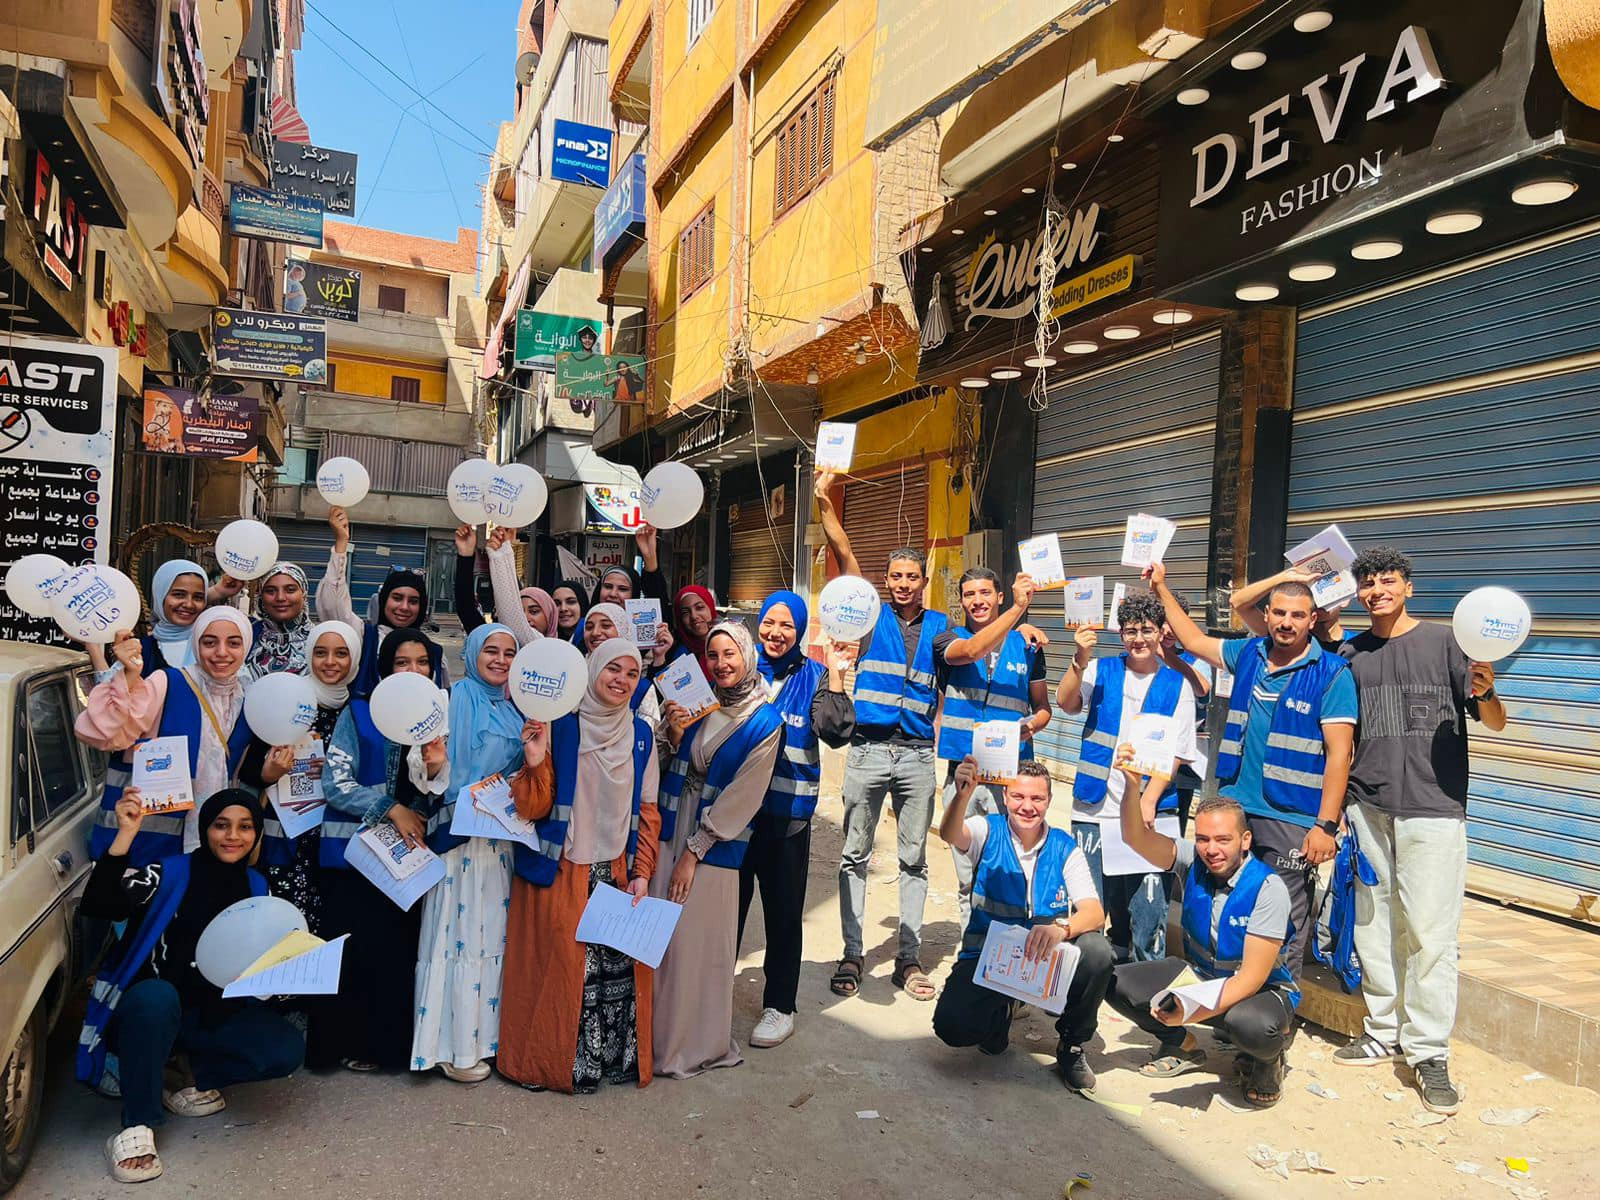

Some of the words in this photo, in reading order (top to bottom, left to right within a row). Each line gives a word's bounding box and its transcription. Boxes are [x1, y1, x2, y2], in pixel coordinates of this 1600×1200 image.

[1189, 25, 1447, 209] DEVA
[301, 145, 330, 162] مركز
[274, 159, 307, 177] سلامة
[1240, 150, 1384, 235] FASHION
[34, 149, 88, 276] FAST
[960, 202, 1100, 332] Queen
[1087, 264, 1130, 293] Dresses
[234, 315, 255, 327] لاب
[257, 319, 296, 331] ميكرو
[534, 329, 577, 350] البوابة
[0, 392, 20, 404] ER
[23, 394, 89, 411] SERVICES
[8, 486, 40, 501] بجميع
[45, 484, 81, 503] طباعة
[4, 506, 40, 522] أسعار
[44, 511, 79, 527] يوجد
[5, 532, 39, 547] لجميع
[43, 532, 79, 549] تقديم
